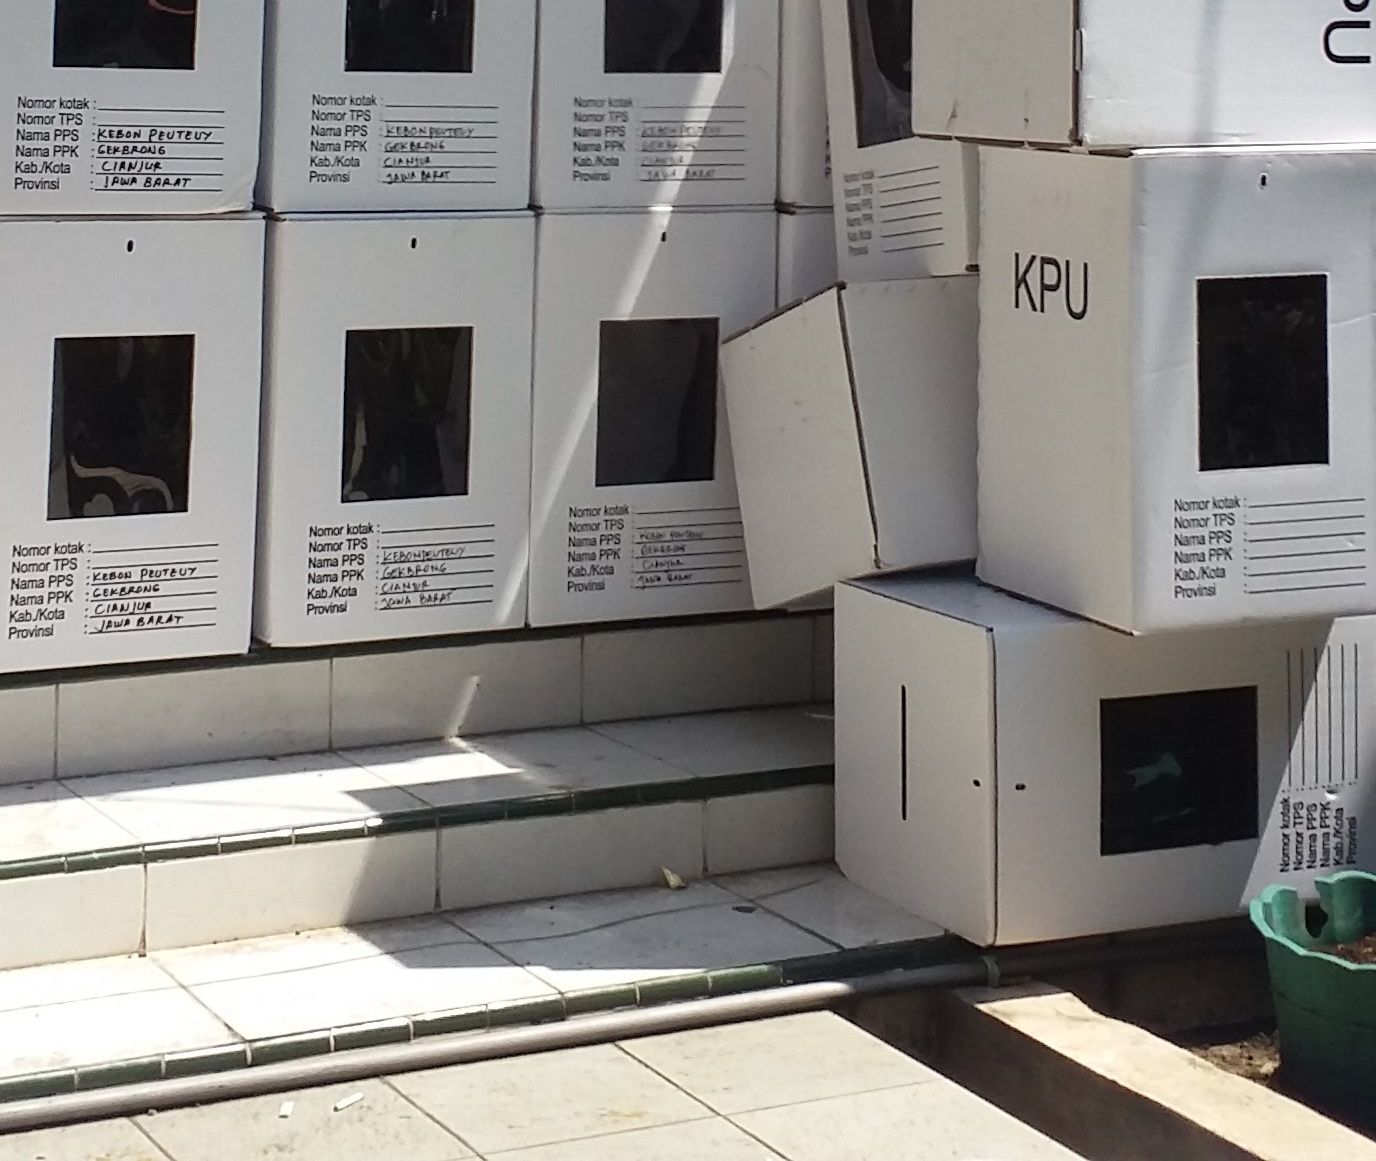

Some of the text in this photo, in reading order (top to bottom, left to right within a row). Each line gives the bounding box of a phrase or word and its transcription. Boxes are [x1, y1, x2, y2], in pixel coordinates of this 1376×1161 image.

[17, 96, 89, 109] Nomor kotak
[17, 112, 83, 126] Nomor TPS
[16, 128, 79, 142] Nama PPS
[97, 127, 212, 142] KEBON PEUTEUY
[15, 145, 79, 157] Nama PPK
[98, 144, 165, 155] GEKBRONG
[15, 161, 70, 174] Kab./Kota
[101, 161, 162, 172] CIANJUR
[14, 177, 59, 190] Provinsi
[104, 174, 191, 188] JAWA BARAT
[1012, 250, 1090, 321] KPU
[1174, 496, 1240, 512] Nomor kotak
[1174, 512, 1235, 529] Nomor TPS
[1174, 529, 1232, 546] Nama PPS
[12, 541, 84, 557] Nomor kotak
[1174, 547, 1232, 564] Nama PPK
[11, 557, 78, 573] Nomor TPS
[1174, 566, 1226, 581] Kab./Kota
[10, 573, 74, 590] Nama PPS
[10, 590, 73, 606] Nama PPK
[1174, 583, 1216, 598] Provinsi
[9, 608, 65, 622] Kab./Kota
[8, 624, 54, 639] Provinsi
